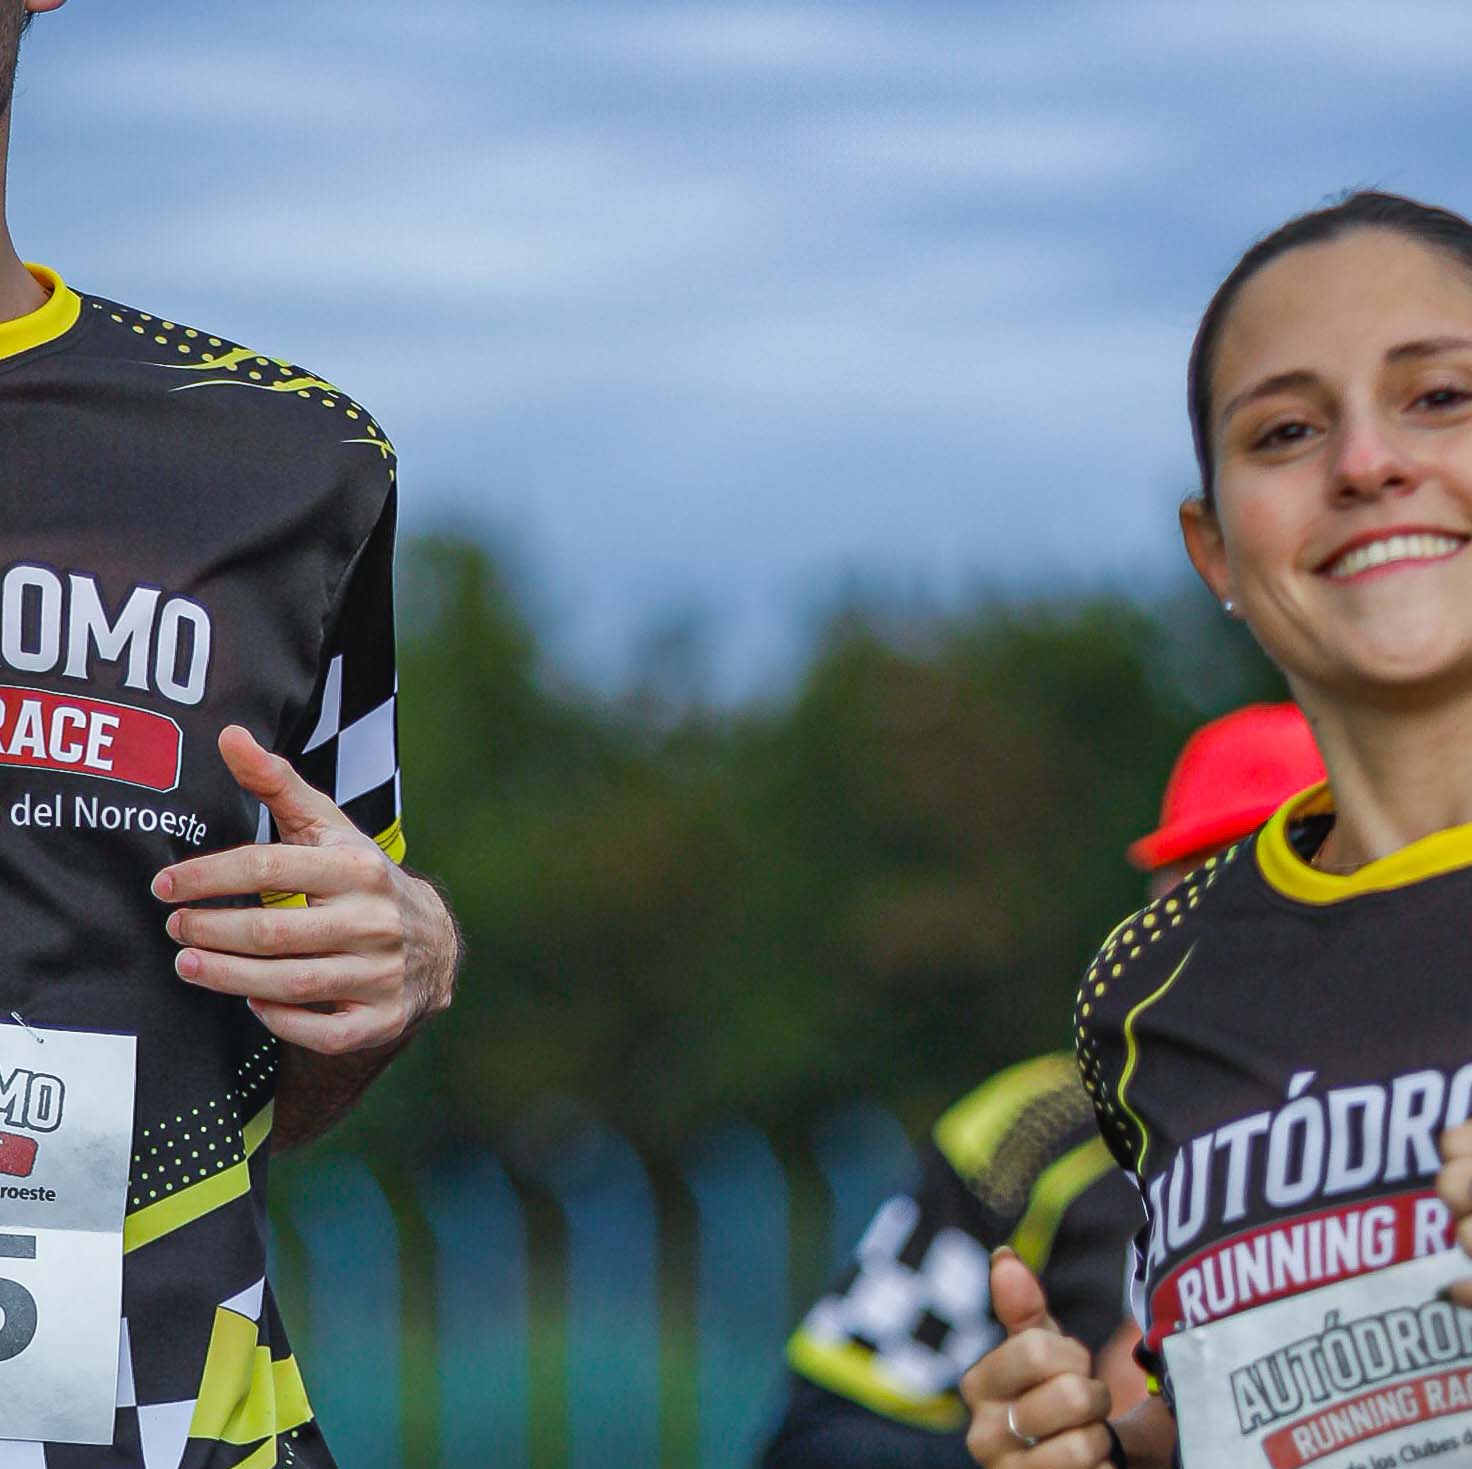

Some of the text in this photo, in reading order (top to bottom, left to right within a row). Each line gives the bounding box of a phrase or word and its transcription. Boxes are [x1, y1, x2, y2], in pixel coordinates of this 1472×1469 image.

[10, 794, 207, 846] del Noroeste
[1177, 1204, 1397, 1329] RUNNING
[1291, 1385, 1419, 1460] RUNNING
[1399, 1435, 1459, 1464] Clubes
